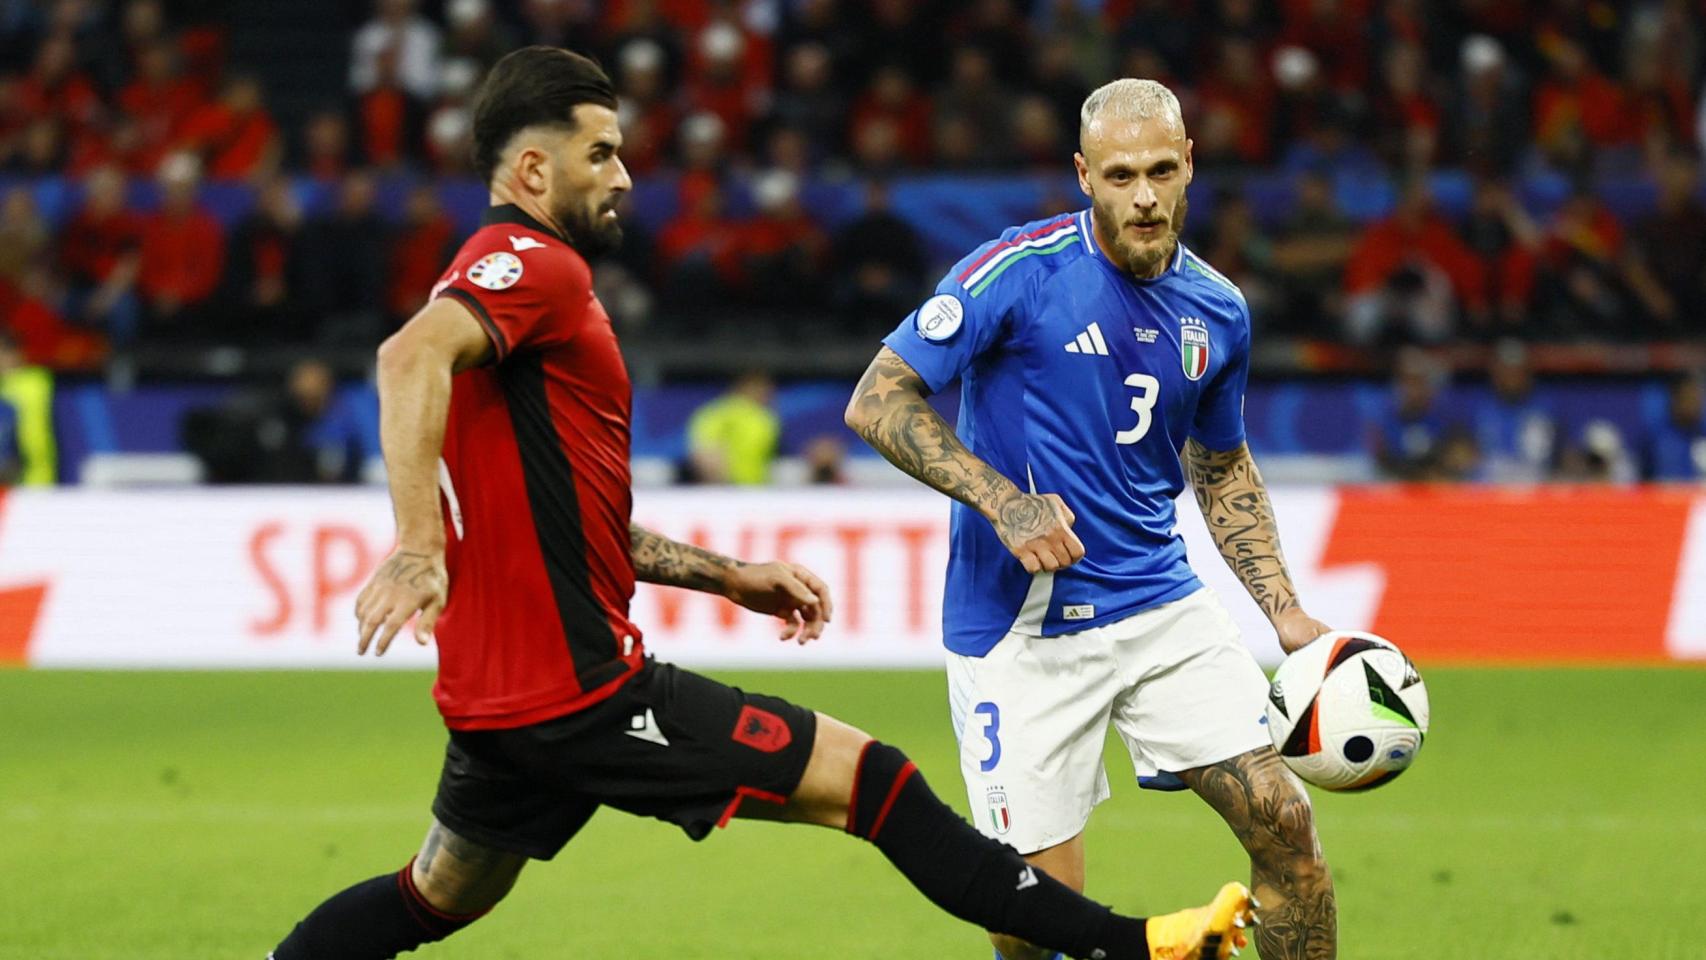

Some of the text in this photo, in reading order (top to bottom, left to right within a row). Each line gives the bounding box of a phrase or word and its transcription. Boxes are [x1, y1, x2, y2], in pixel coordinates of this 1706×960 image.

[1183, 330, 1206, 343] ITALIA
[1115, 373, 1160, 445] 3
[1210, 511, 1281, 604] Nicholas
[974, 701, 1001, 772] 3
